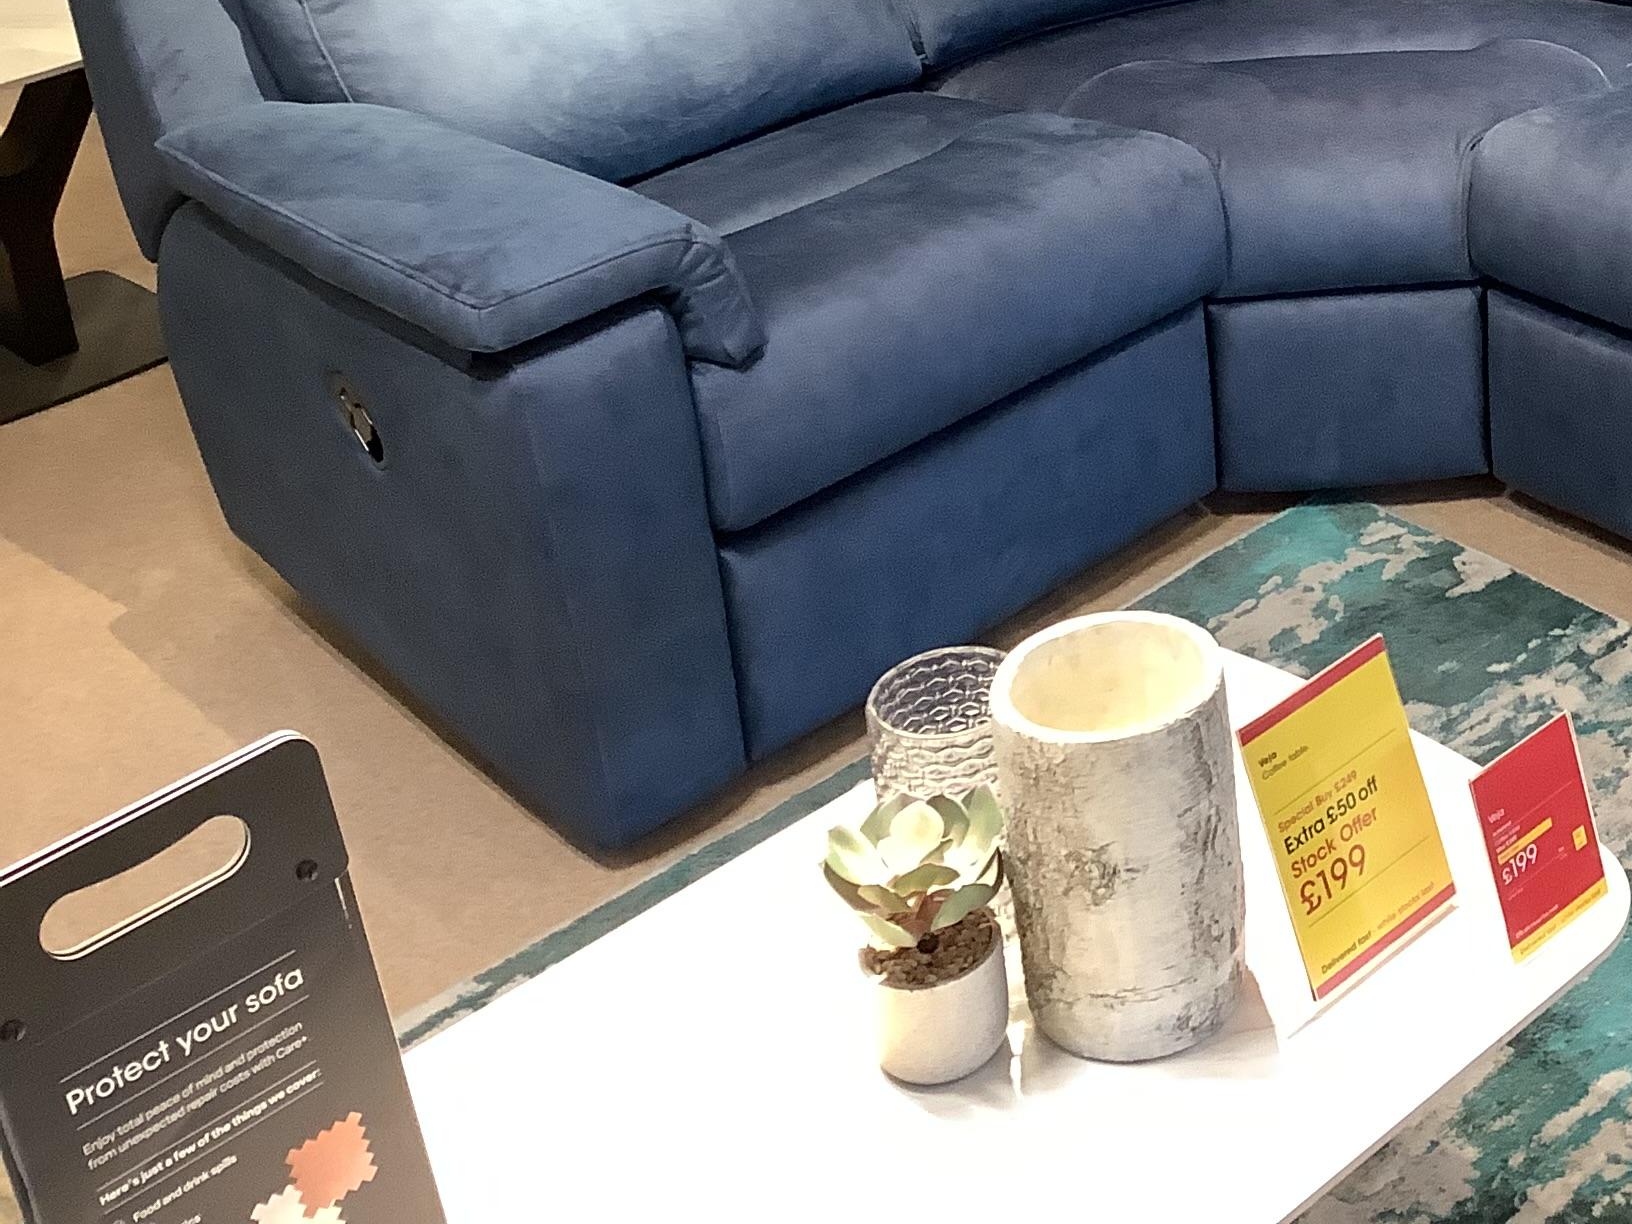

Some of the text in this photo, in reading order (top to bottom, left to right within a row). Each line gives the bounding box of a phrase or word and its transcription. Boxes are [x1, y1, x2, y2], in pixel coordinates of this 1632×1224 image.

[1278, 801, 1314, 833] Special
[1284, 775, 1377, 855] Extra £50 off
[1291, 808, 1377, 878] Stock Offer
[1300, 844, 1365, 915] £199
[1502, 843, 1537, 886] £199
[65, 968, 304, 1117] Protect your sofa
[82, 1021, 303, 1156] Enjoy total peace of mind and protection
[87, 1149, 118, 1171] from
[118, 1108, 186, 1154] unexpected
[187, 1087, 218, 1116] repair
[219, 1071, 251, 1092] costs
[251, 1053, 276, 1074] with
[99, 1176, 140, 1206] Here's
[140, 1163, 165, 1186] just
[165, 1159, 173, 1168] a
[172, 1144, 197, 1163] few
[197, 1132, 211, 1148] of
[211, 1123, 231, 1140] the
[231, 1102, 268, 1128] things
[268, 1090, 286, 1105] we
[133, 1198, 161, 1223] Food
[162, 1185, 183, 1206] and
[183, 1170, 210, 1194] drink
